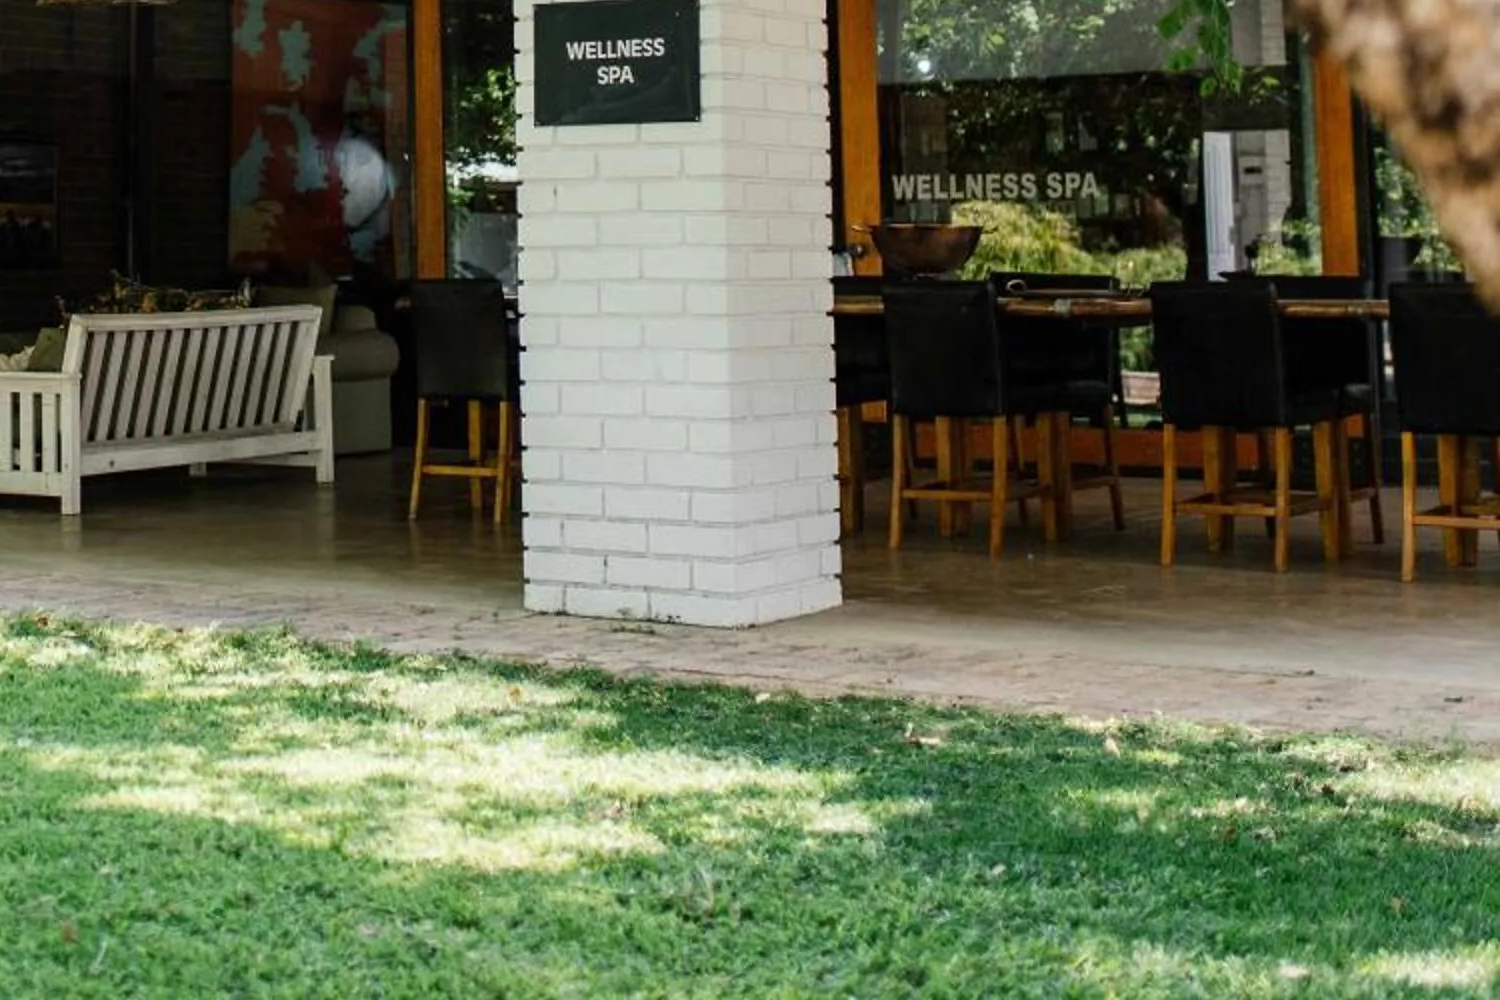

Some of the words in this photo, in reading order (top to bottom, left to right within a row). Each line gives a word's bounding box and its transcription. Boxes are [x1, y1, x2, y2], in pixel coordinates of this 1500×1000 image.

[566, 38, 665, 60] WELLNESS
[597, 65, 634, 85] SPA
[892, 172, 1038, 200] WELLNESS
[1046, 171, 1100, 199] SPA
